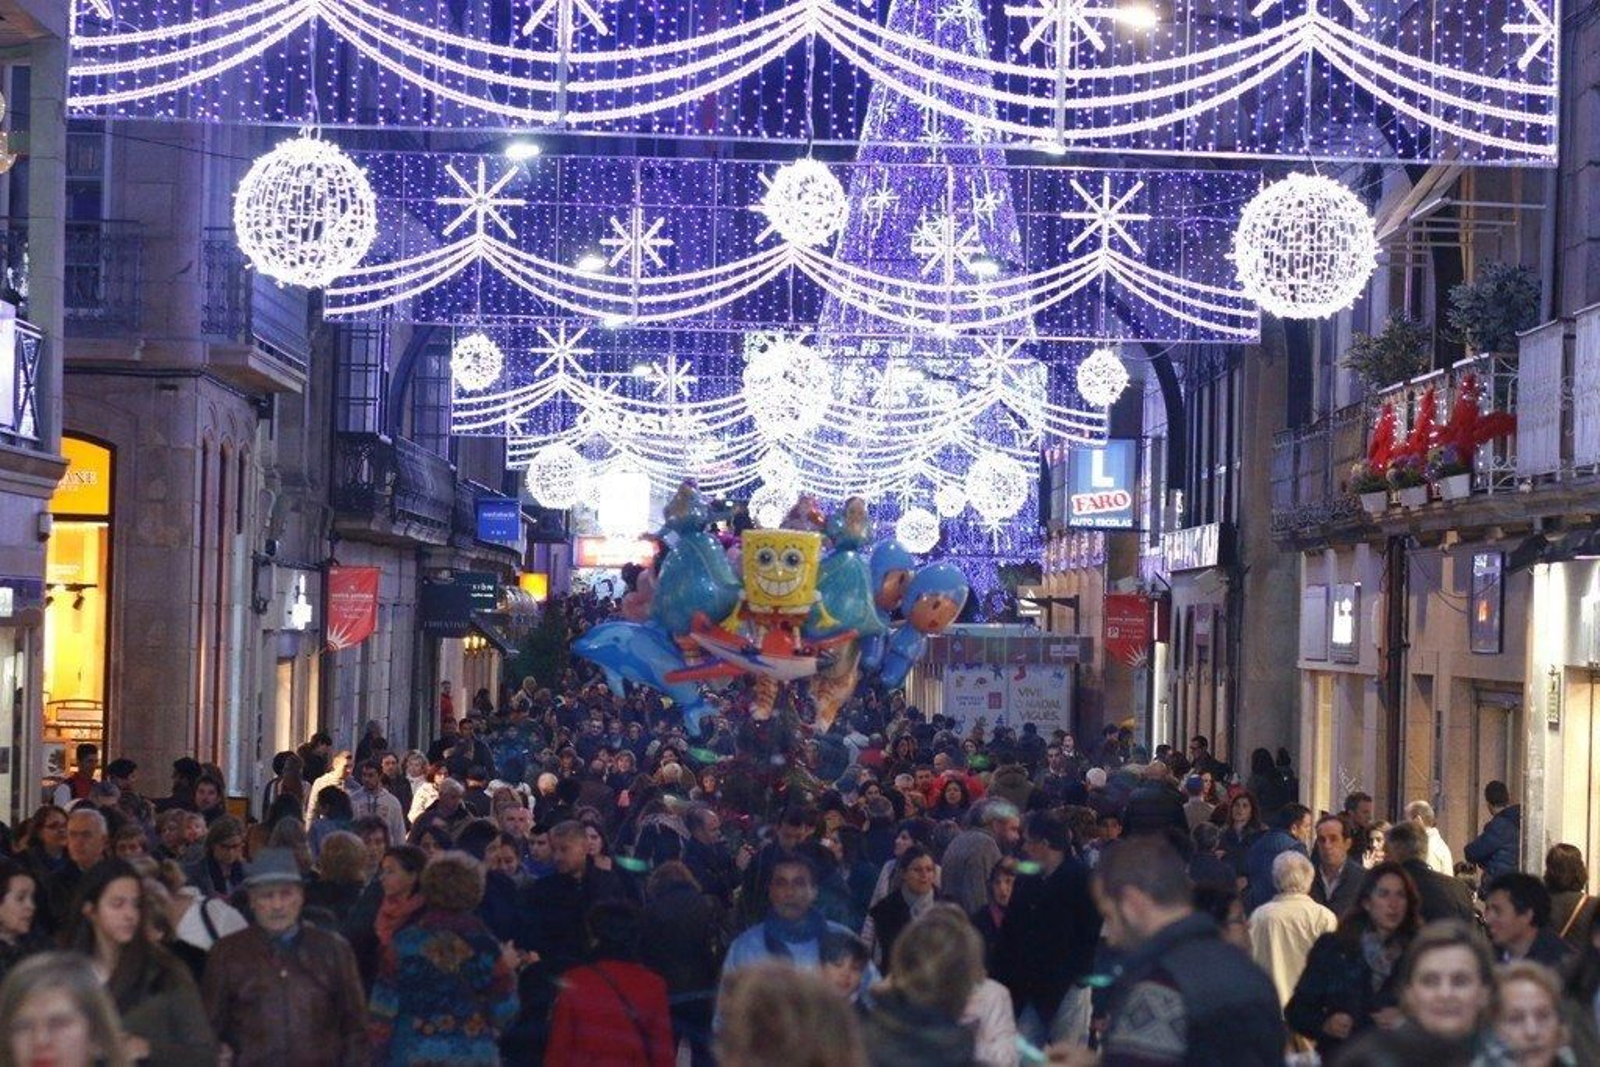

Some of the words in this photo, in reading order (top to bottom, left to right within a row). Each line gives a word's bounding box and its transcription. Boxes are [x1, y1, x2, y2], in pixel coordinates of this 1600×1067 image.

[1091, 449, 1115, 488] L
[1075, 492, 1128, 512] FARO
[1069, 517, 1094, 526] AUTO
